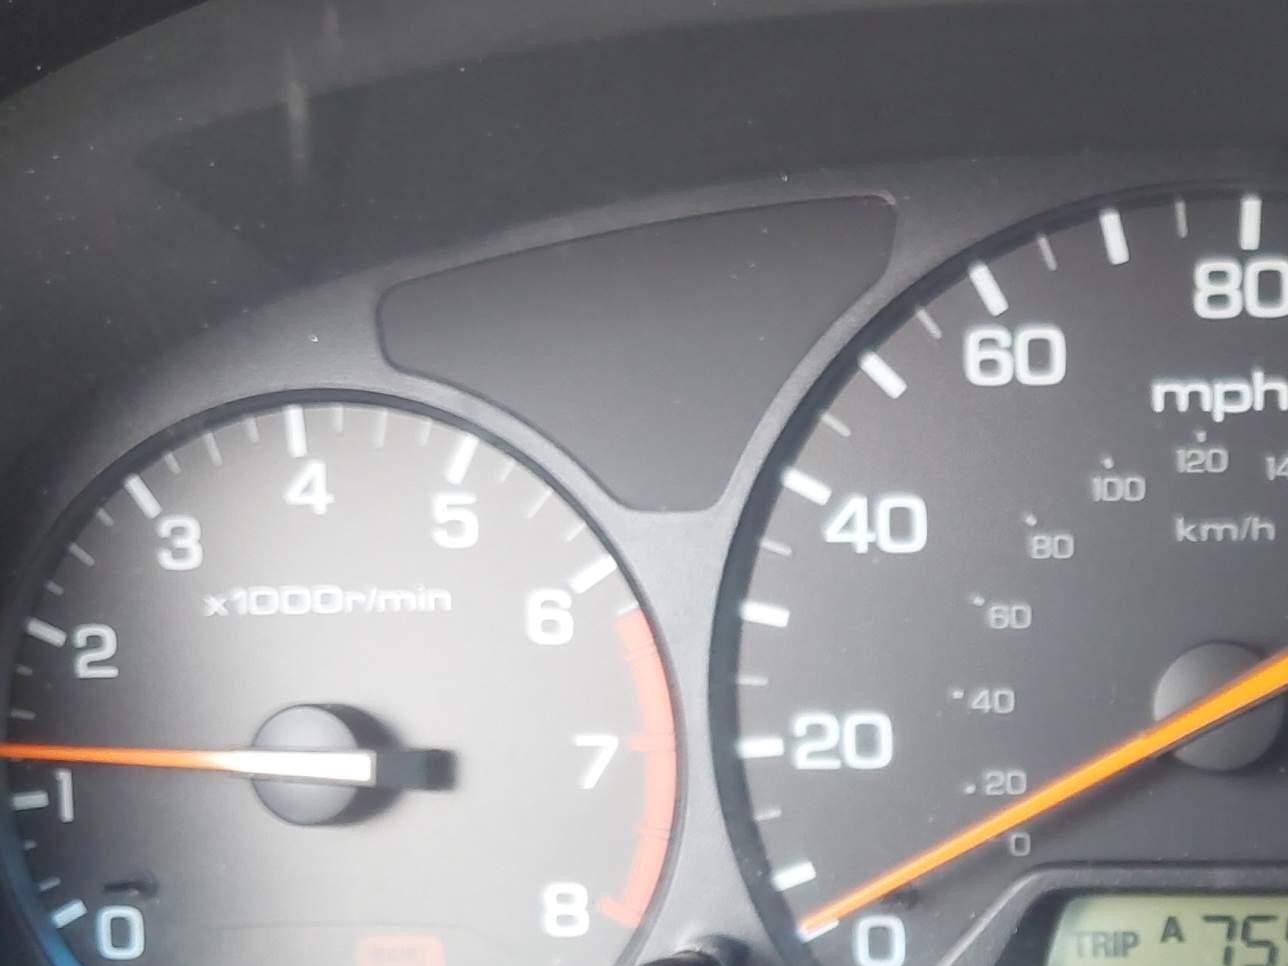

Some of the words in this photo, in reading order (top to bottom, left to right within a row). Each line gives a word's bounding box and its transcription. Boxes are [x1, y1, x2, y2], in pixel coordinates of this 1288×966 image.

[963, 326, 1067, 386] 60
[1176, 449, 1229, 474] 120
[285, 461, 334, 515] 4
[1092, 476, 1145, 502] 100
[157, 516, 203, 570] 3
[433, 493, 479, 548] 5
[824, 495, 928, 554] 40
[1175, 517, 1276, 542] km/h
[1029, 535, 1075, 560] 80
[204, 586, 452, 617] x1000r/min
[526, 590, 574, 645] 6
[988, 605, 1032, 629] 60
[73, 625, 119, 679] 2
[971, 688, 1015, 714] 40
[574, 734, 619, 789] 7
[792, 712, 894, 770] 20
[56, 770, 74, 822] 1
[984, 771, 1027, 796] 20
[1009, 832, 1031, 857] 0
[98, 908, 145, 960] 0
[541, 883, 590, 937] 8
[1074, 931, 1140, 958] TRIP
[1160, 916, 1185, 943] A
